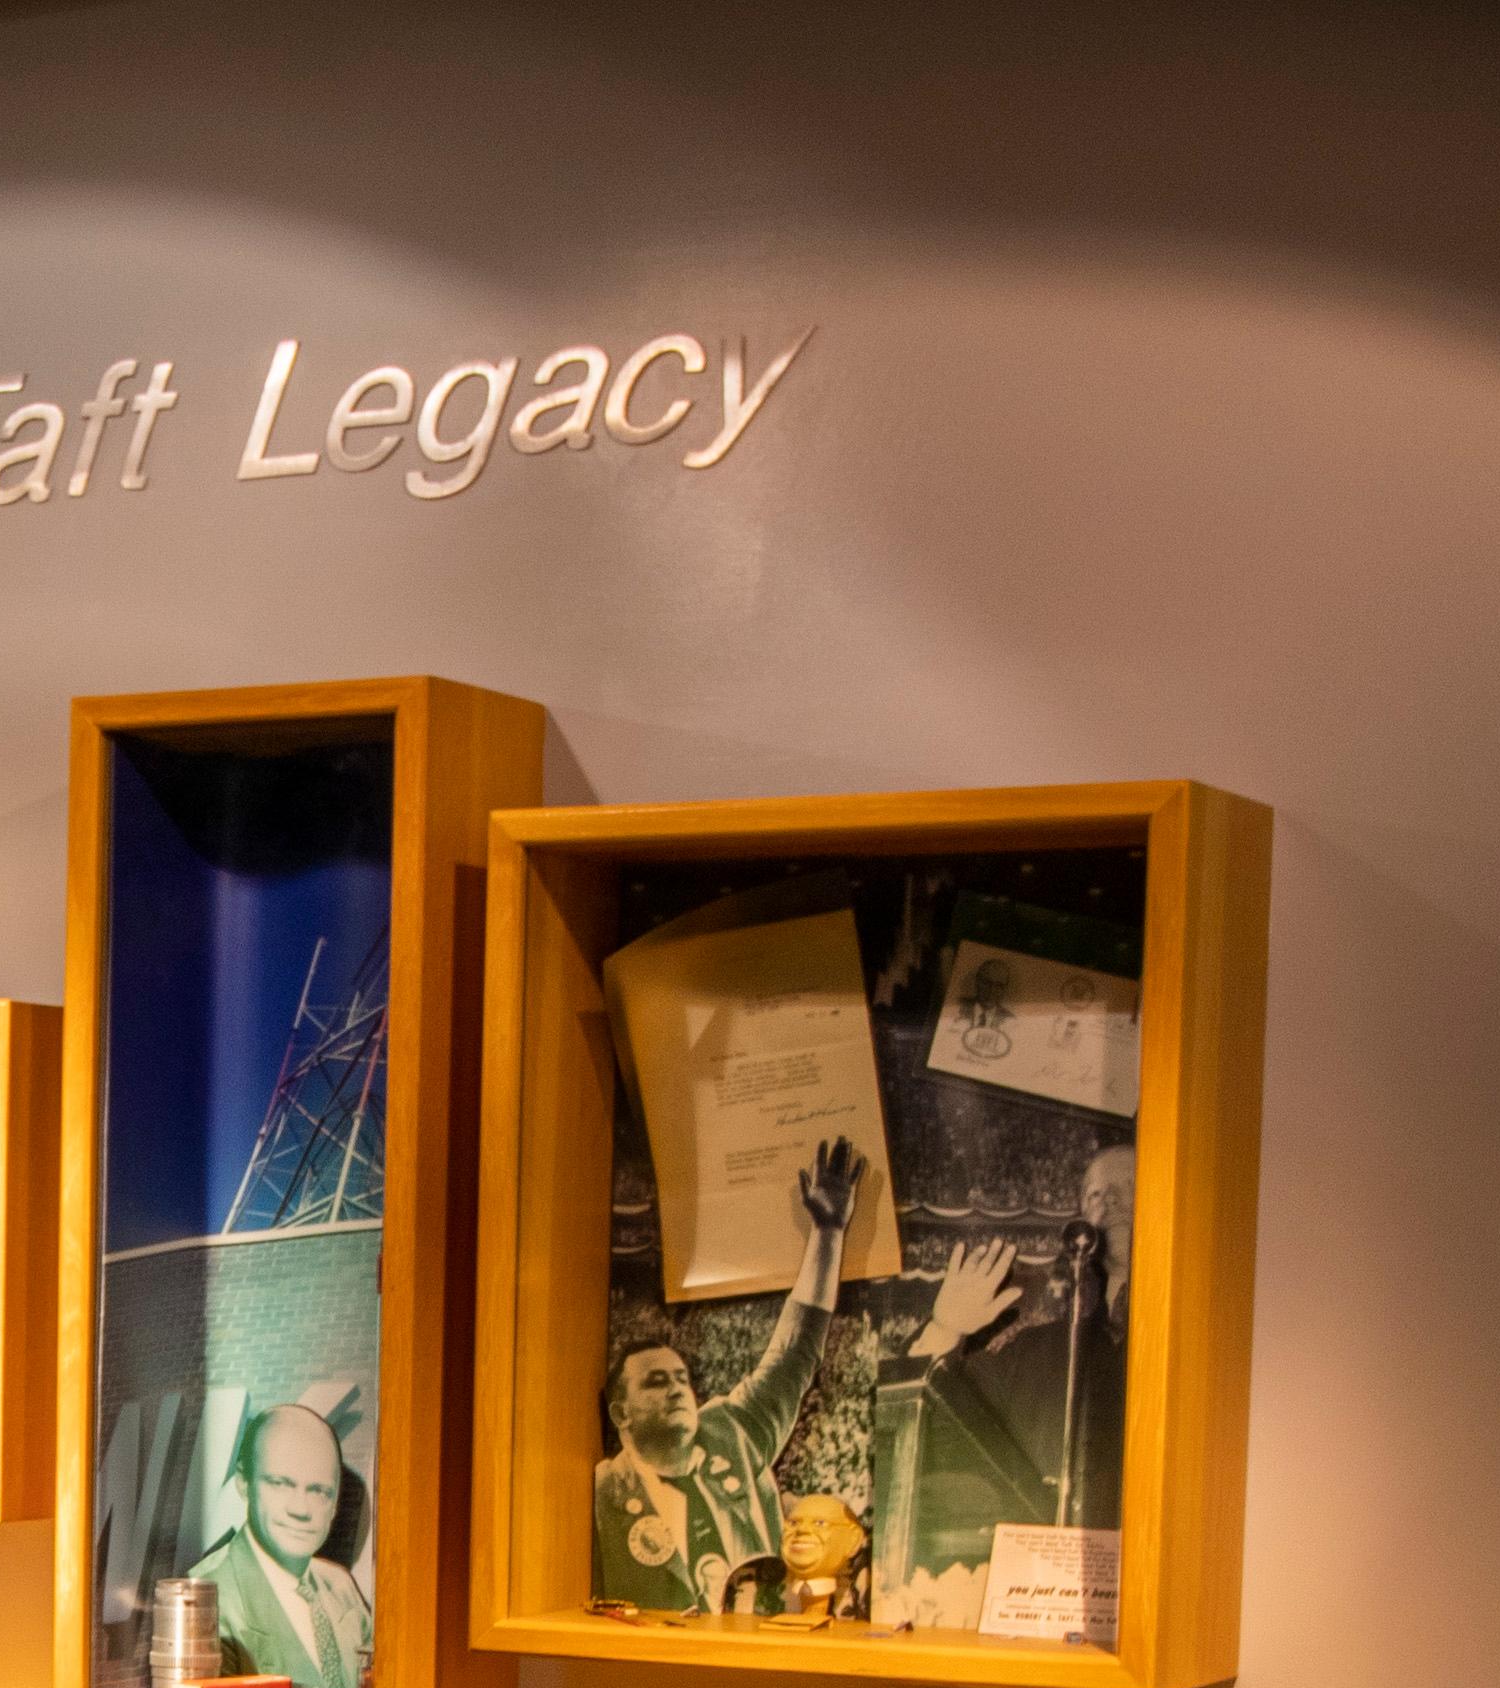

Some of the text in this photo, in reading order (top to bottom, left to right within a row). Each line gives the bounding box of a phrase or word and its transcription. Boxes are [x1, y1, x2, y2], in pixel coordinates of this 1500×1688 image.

[236, 322, 818, 500] Legacy
[1007, 1585, 1030, 1597] you
[1031, 1584, 1056, 1599] just
